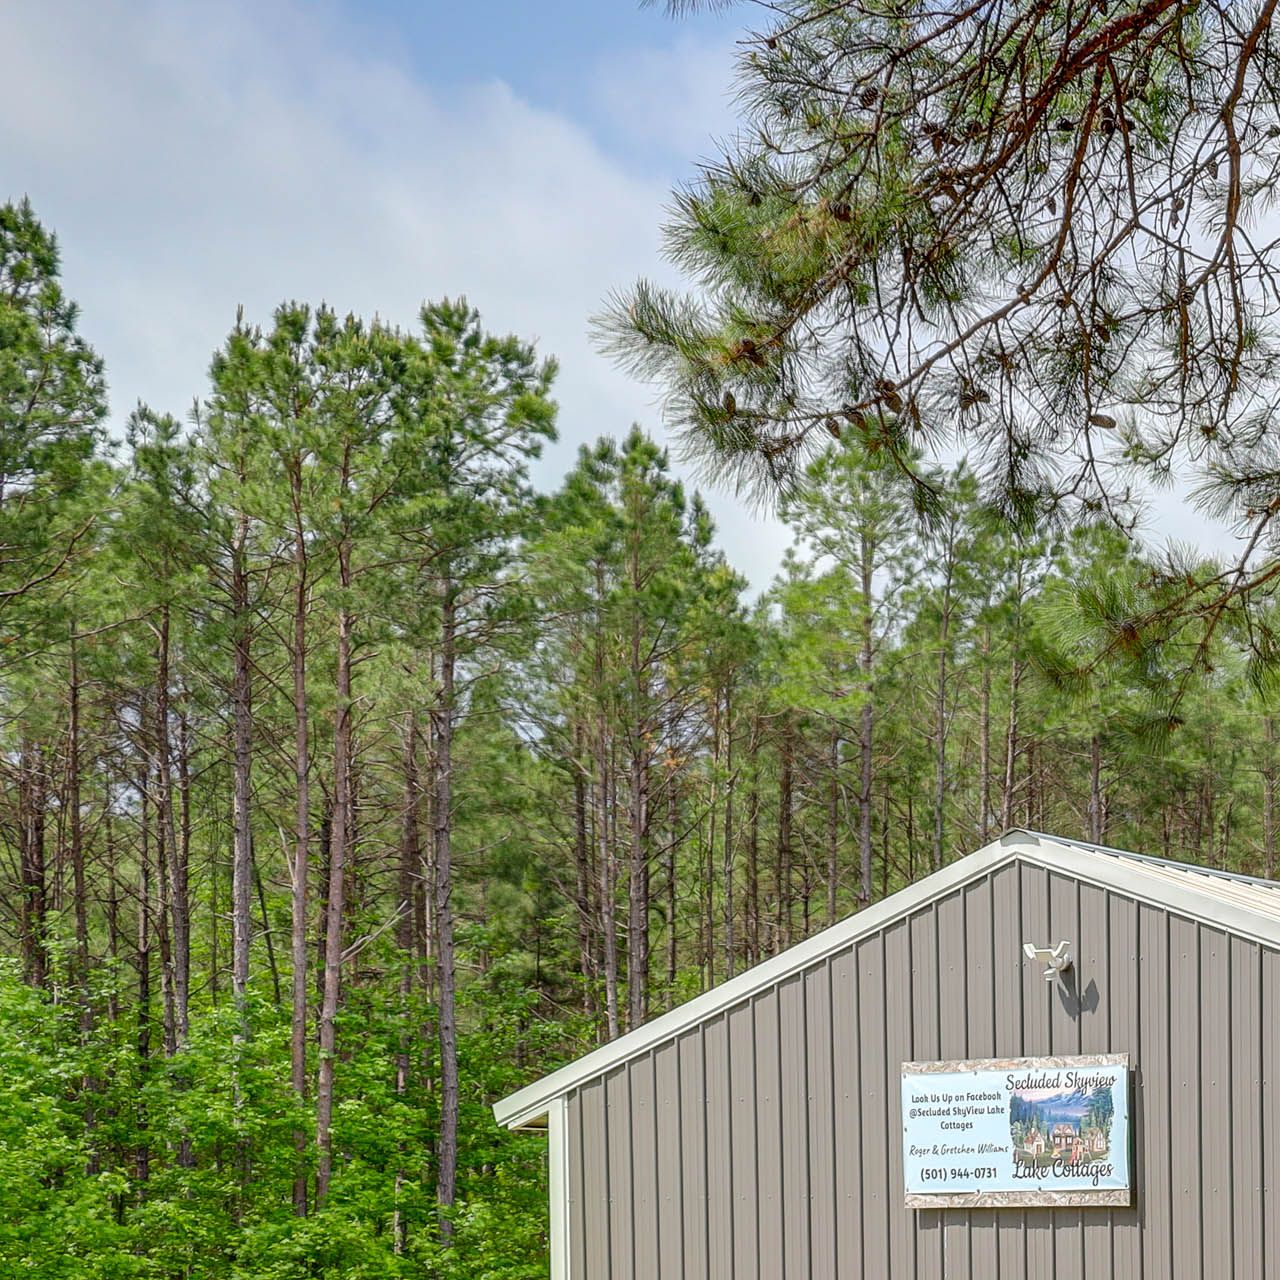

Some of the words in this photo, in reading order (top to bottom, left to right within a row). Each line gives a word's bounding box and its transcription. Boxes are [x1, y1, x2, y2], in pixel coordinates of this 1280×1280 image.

[1005, 1072, 1061, 1090] Secluded
[1065, 1072, 1117, 1095] Skyview
[911, 1094, 928, 1103] Look
[931, 1094, 940, 1103] Us
[942, 1093, 952, 1104] Up
[966, 1091, 1001, 1102] Facebook
[909, 1107, 950, 1119] @Secluded
[953, 1106, 985, 1117] SkyView
[987, 1105, 1005, 1114] Lake
[940, 1121, 973, 1131] Cottages
[909, 1145, 932, 1157] Roger
[932, 1145, 939, 1156] &
[940, 1144, 975, 1155] Gretchen
[977, 1143, 1009, 1154] Williams
[920, 1168, 947, 1182] (501)
[950, 1167, 997, 1179] 944-0731
[1012, 1159, 1050, 1180] Lake
[1052, 1158, 1114, 1186] Cottages
